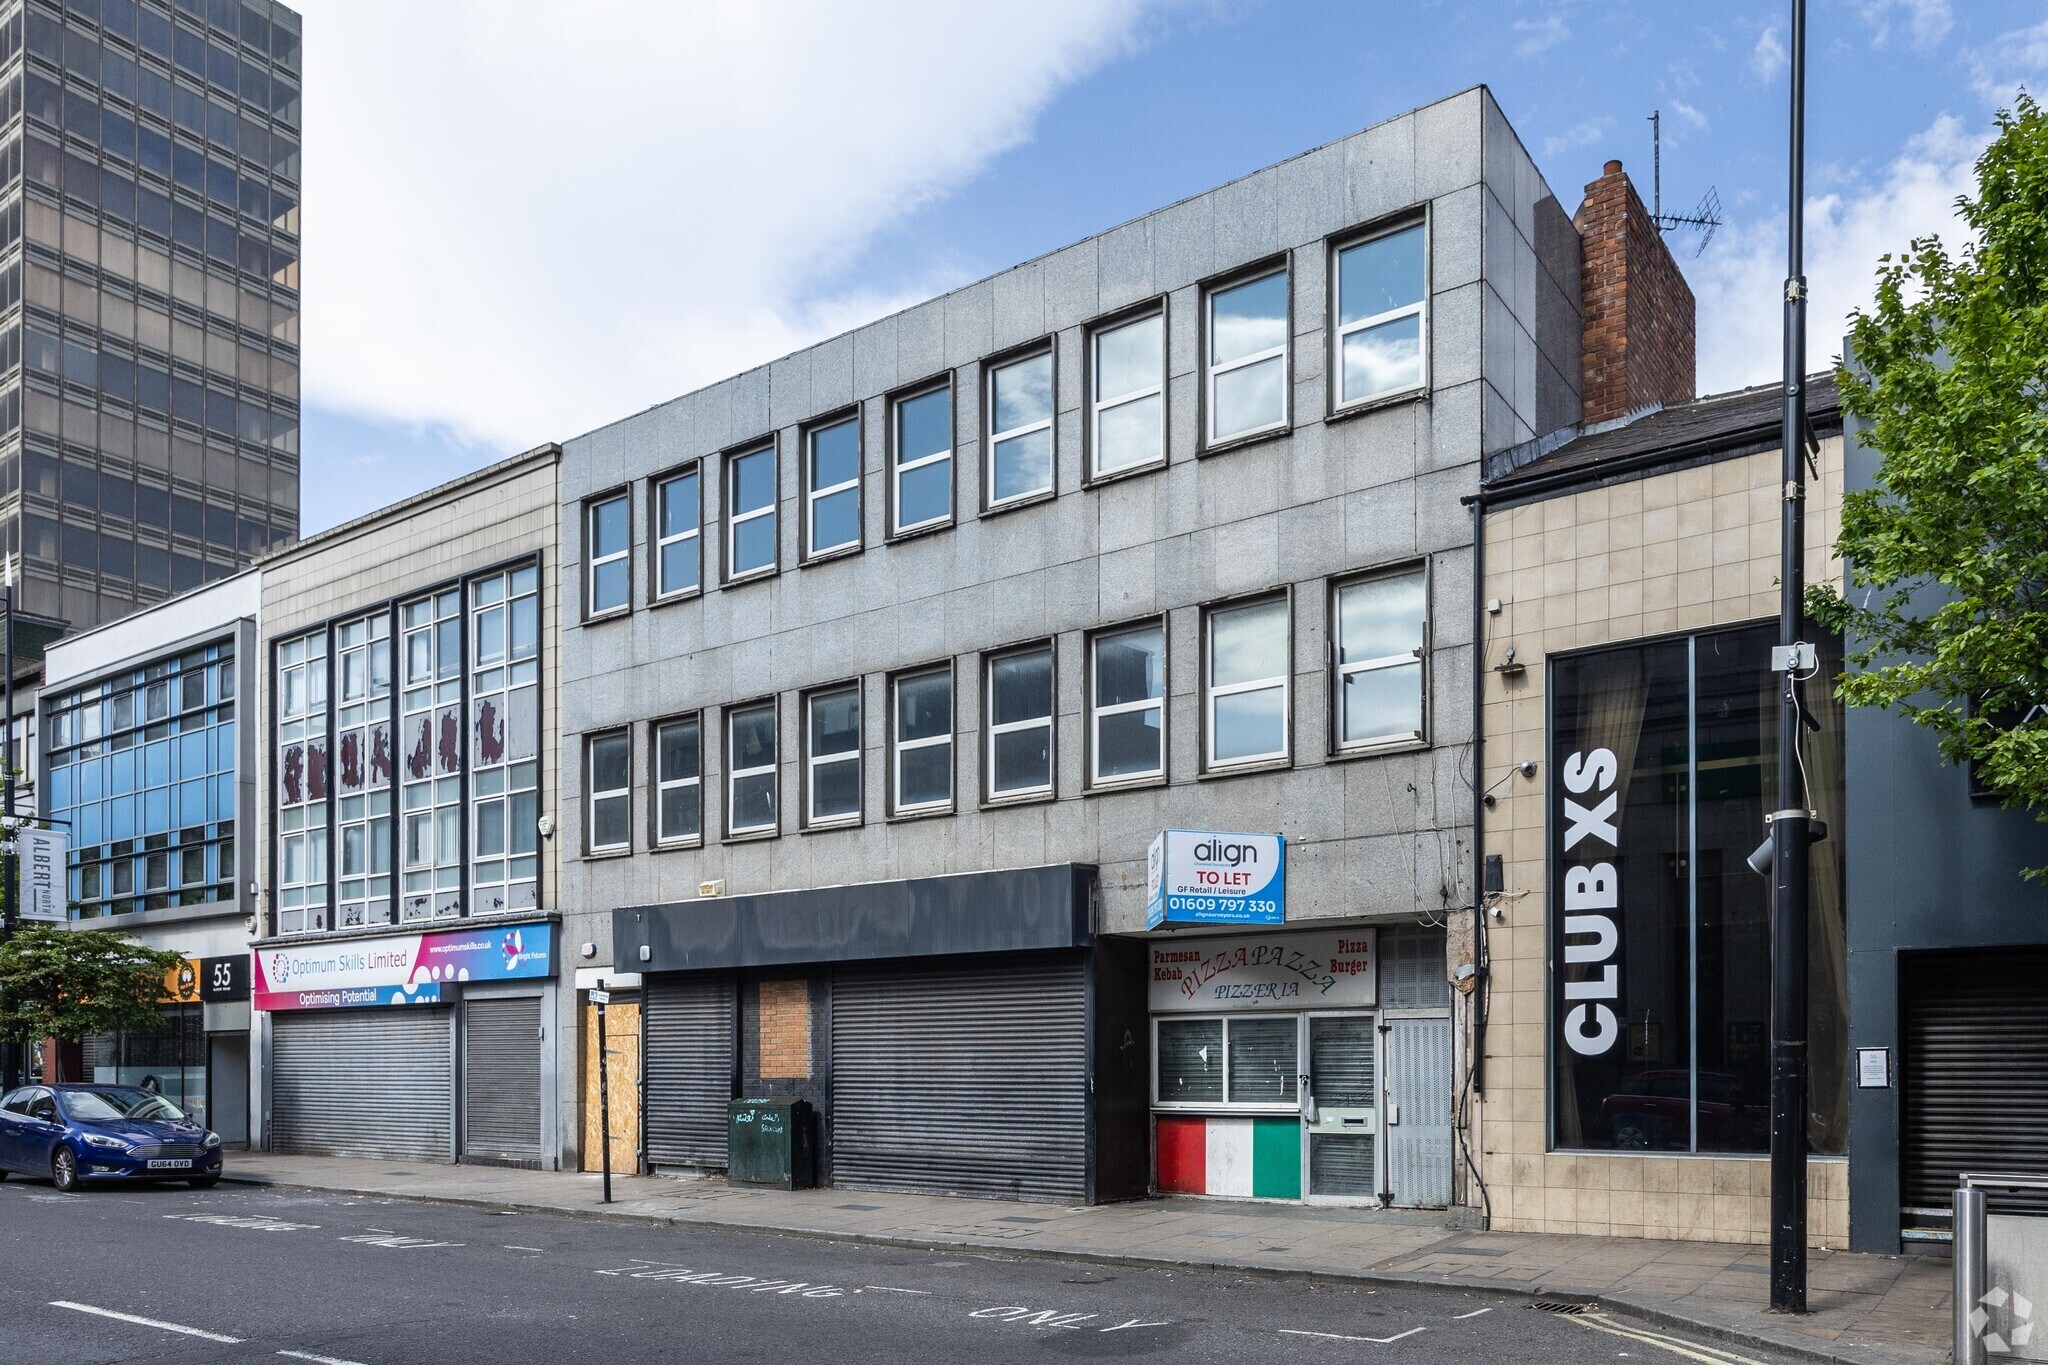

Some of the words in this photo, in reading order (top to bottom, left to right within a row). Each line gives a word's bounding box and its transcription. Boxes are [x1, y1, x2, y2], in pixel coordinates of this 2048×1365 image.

[1563, 748, 1618, 853] XS
[1194, 836, 1258, 867] align
[33, 837, 51, 889] ALBERT
[1197, 871, 1220, 885] TO
[1224, 872, 1251, 886] LET
[1190, 886, 1212, 894] Retail
[1218, 887, 1246, 895] Leisure
[1169, 897, 1216, 910] 01609
[1219, 899, 1245, 911] 797
[1248, 900, 1276, 912] 330
[429, 940, 492, 954] www.optimumskills.co.uk
[1338, 939, 1368, 954] Pizza
[292, 958, 336, 977] Optimum
[339, 954, 365, 972] Skills
[368, 949, 407, 969] Limited
[1154, 950, 1201, 964] Parmesan
[1564, 862, 1618, 1056] CLUB
[213, 963, 231, 987] 55
[1154, 967, 1183, 981] Kebab
[1330, 959, 1368, 976] Burger
[300, 992, 340, 1008] Optimising
[342, 988, 377, 1003] Potential
[1214, 982, 1301, 1000] PIZZERIA
[151, 1160, 172, 1168] GU64
[174, 1160, 190, 1168] OVD
[594, 1266, 845, 1298] LOADING
[968, 1306, 1168, 1332] ONLY
